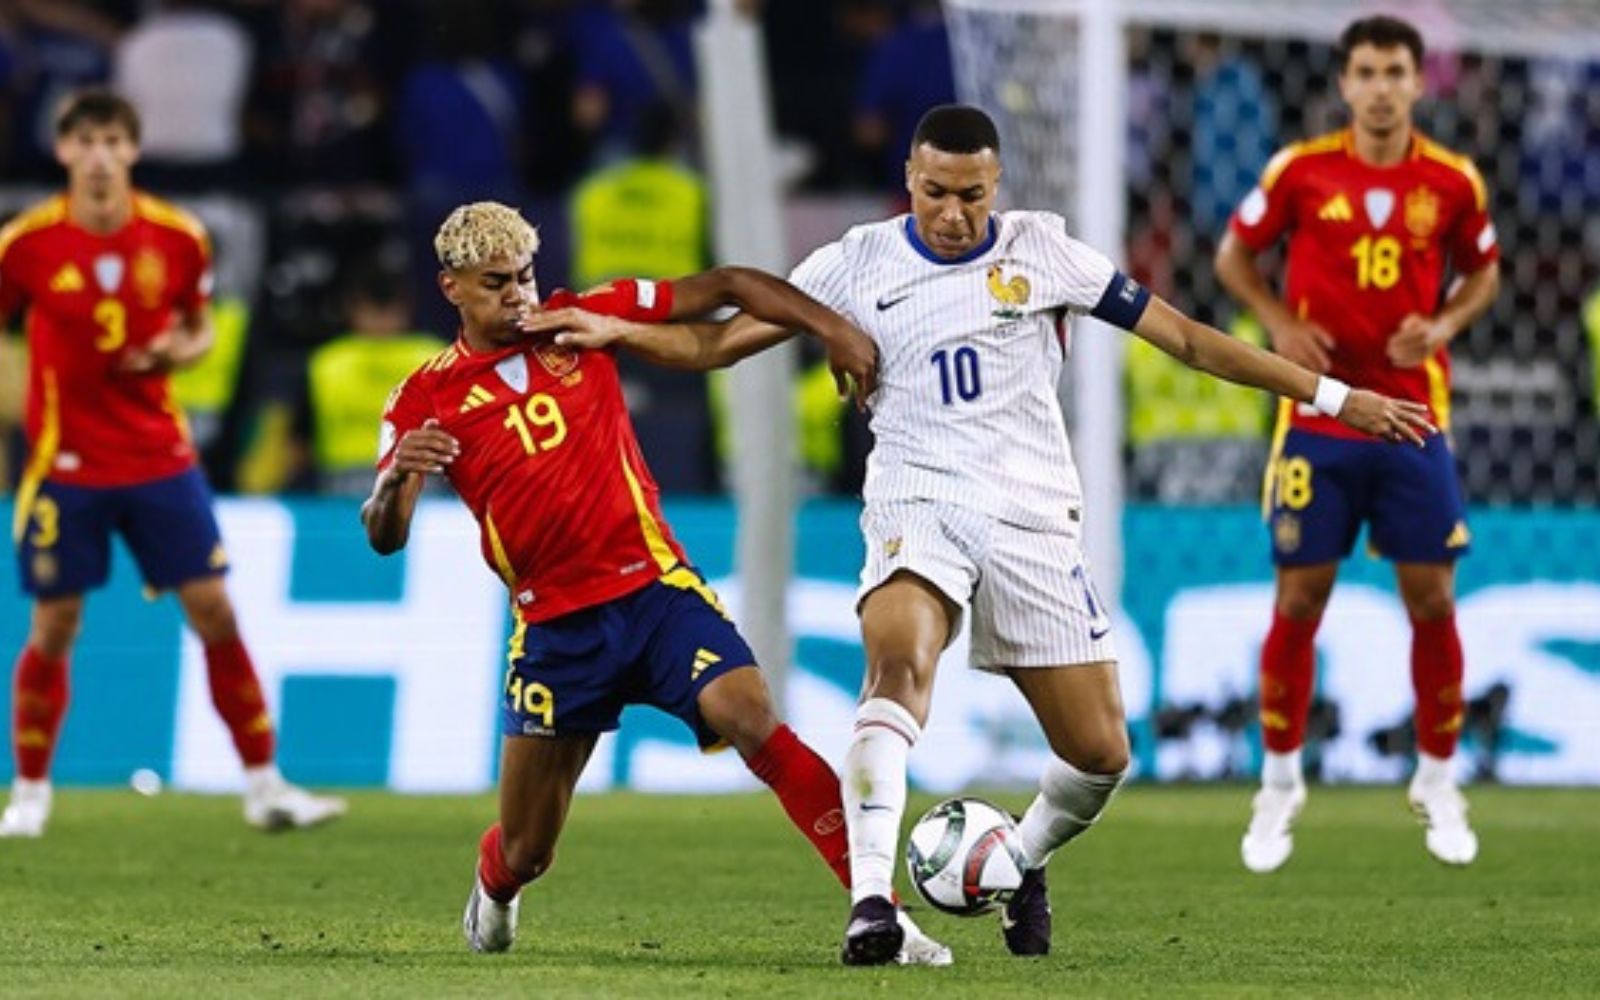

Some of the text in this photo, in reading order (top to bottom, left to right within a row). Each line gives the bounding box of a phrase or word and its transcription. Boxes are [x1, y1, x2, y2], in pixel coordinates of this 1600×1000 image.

[1350, 234, 1401, 290] 18
[93, 298, 126, 352] 3
[930, 346, 982, 405] 10
[503, 392, 567, 455] 19
[1274, 456, 1313, 510] 18
[30, 497, 58, 548] 3
[509, 676, 554, 727] 19
